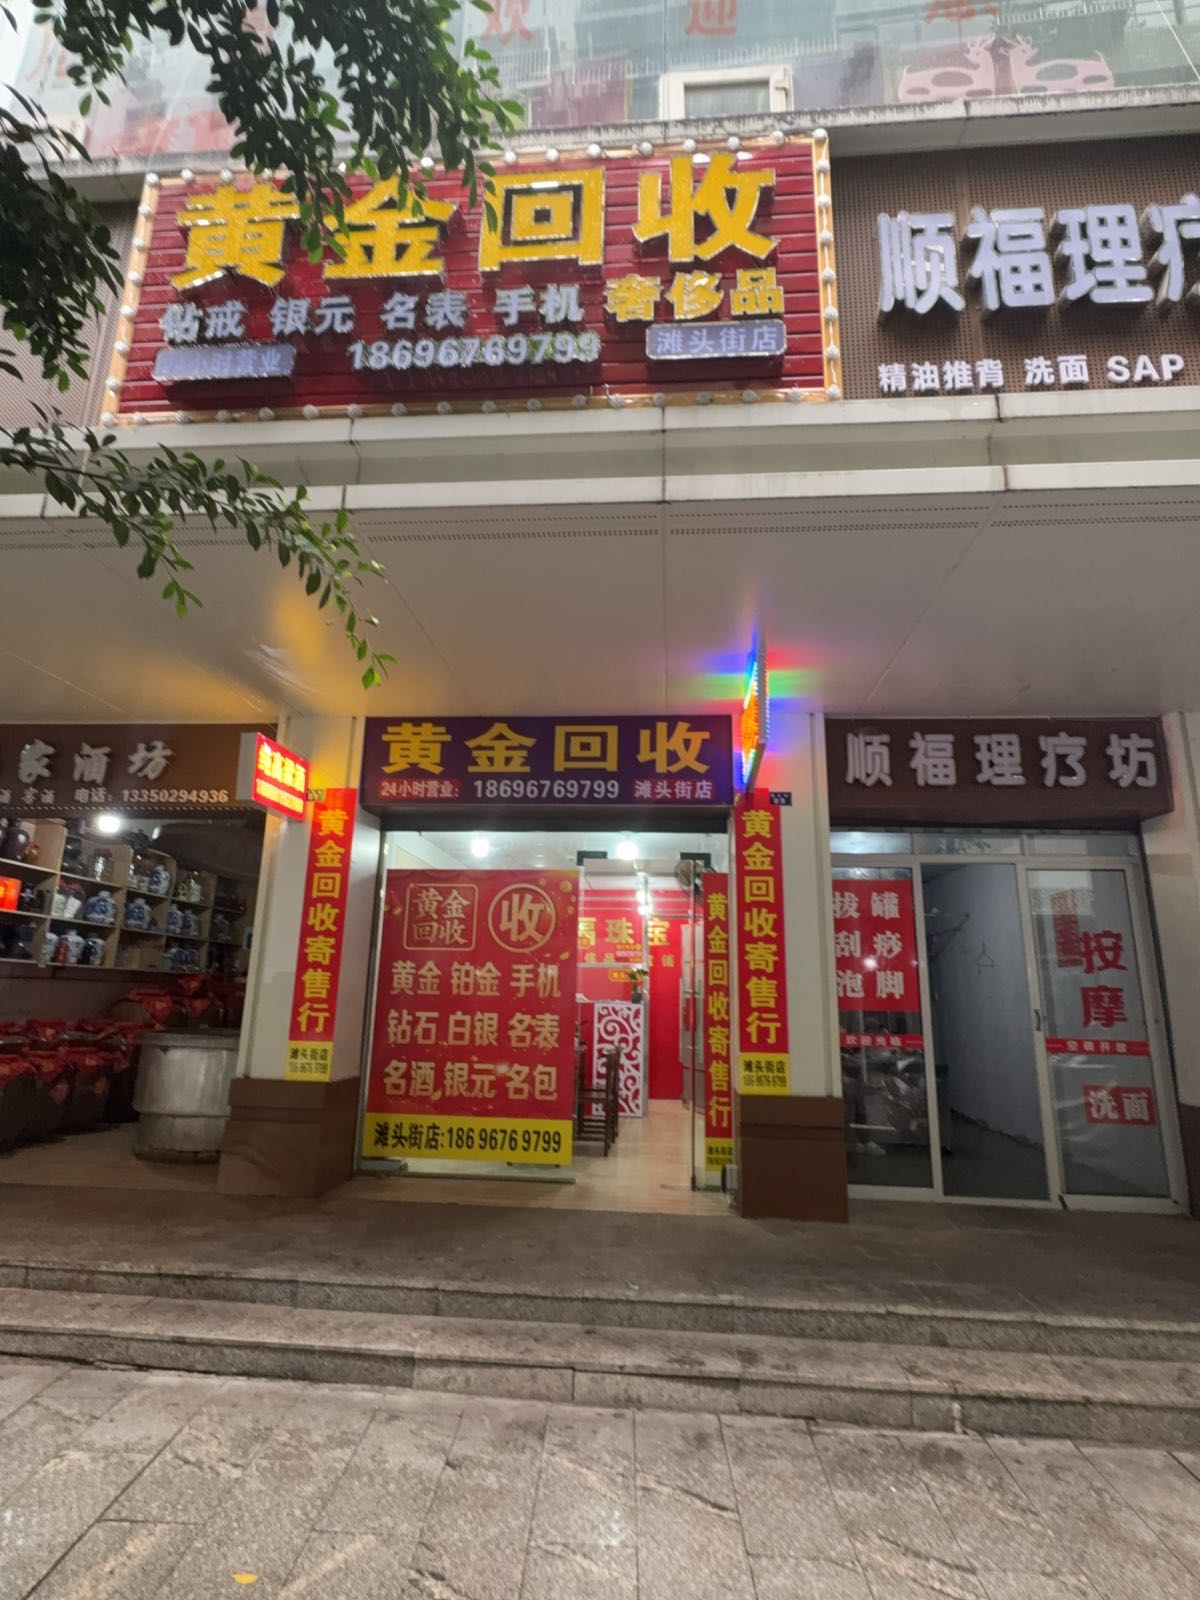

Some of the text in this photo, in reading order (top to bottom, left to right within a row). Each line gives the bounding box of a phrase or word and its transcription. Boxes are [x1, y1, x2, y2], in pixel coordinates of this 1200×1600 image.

[171, 151, 778, 290] 黄金回收
[160, 283, 585, 344] 钻戒 银元 名表 手机
[603, 267, 787, 323] 奢侈品
[347, 328, 601, 372] 18696769799
[656, 325, 777, 355] 滩头街店
[878, 353, 1186, 393] 精油推背 洗面 SAP
[380, 720, 712, 775] 黄金回收
[845, 731, 1157, 788] 顺福理疗坊
[121, 788, 229, 804] 13350294936
[473, 780, 619, 800] 18696769799
[633, 780, 713, 800] 滩头街店
[297, 808, 350, 1035] 黄金回收寄售行
[411, 888, 471, 920] 黄金
[500, 893, 546, 942] 收
[412, 920, 468, 946] 回收
[741, 809, 782, 1046] 黄金回收寄售行
[834, 930, 904, 959] 刮痧
[390, 960, 562, 999] 黄金 铂金 手机
[836, 969, 906, 1000] 泡脚
[1078, 929, 1130, 1029] 按摩
[386, 1008, 561, 1049] 钻石 白银 名表
[705, 892, 731, 1130] 黄金回收寄售行
[383, 1060, 558, 1101] 名酒 银元 名包
[1087, 1089, 1152, 1121] 洗面
